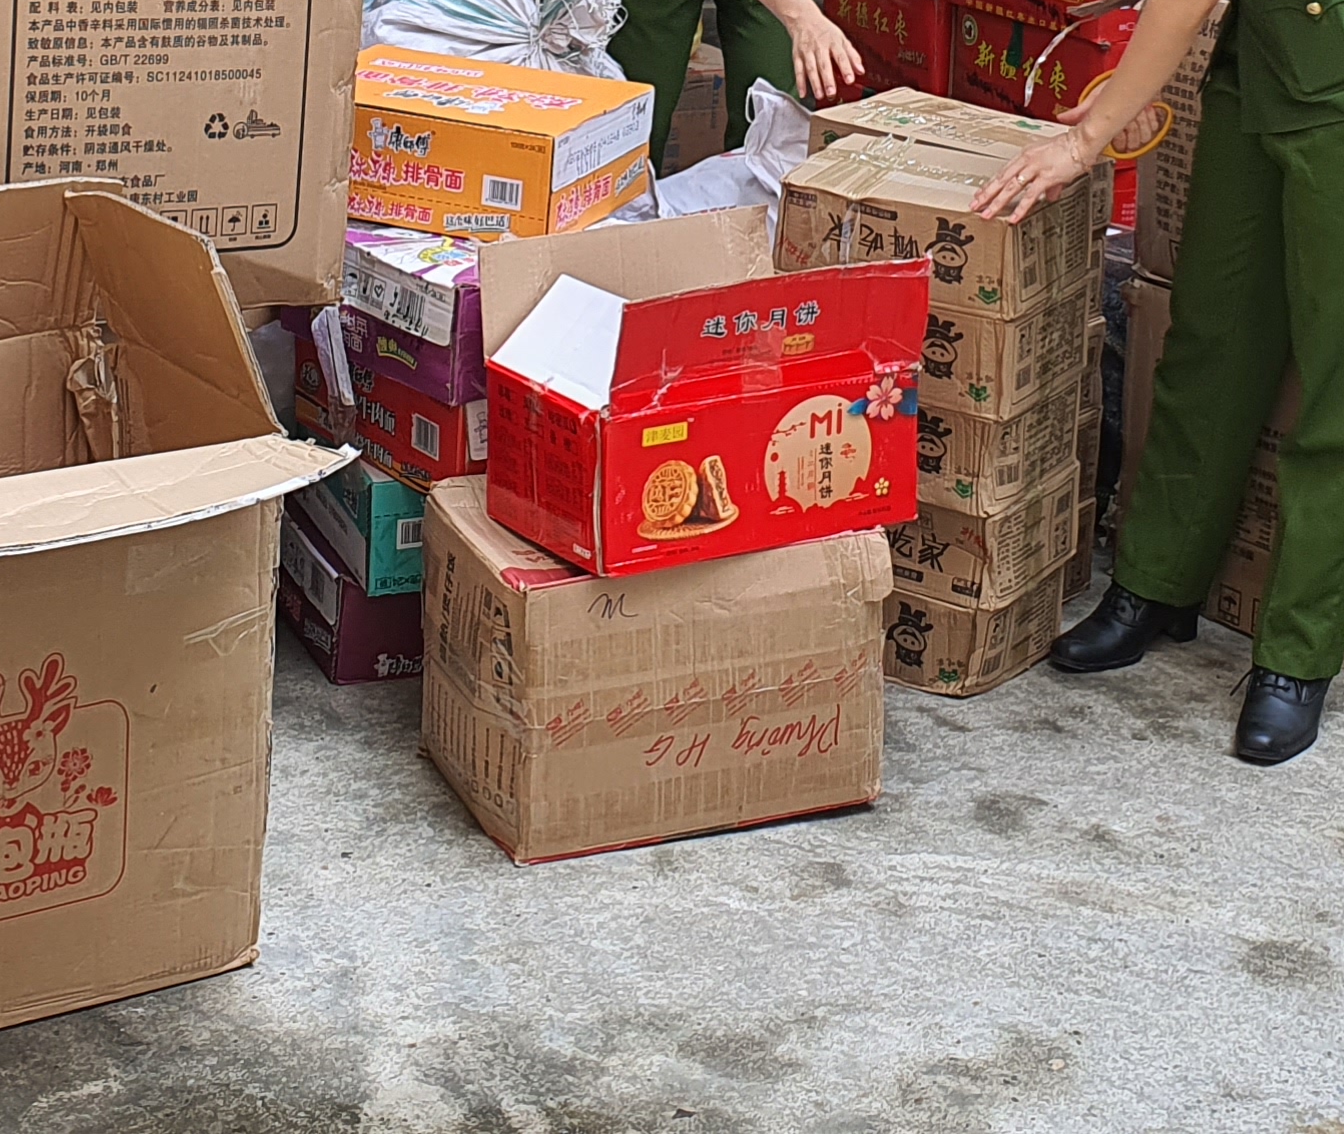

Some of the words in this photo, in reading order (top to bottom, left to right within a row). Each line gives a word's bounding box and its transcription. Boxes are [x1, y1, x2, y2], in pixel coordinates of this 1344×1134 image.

[701, 301, 821, 337] 迷你月饼
[818, 442, 834, 499] 迷你月饼
